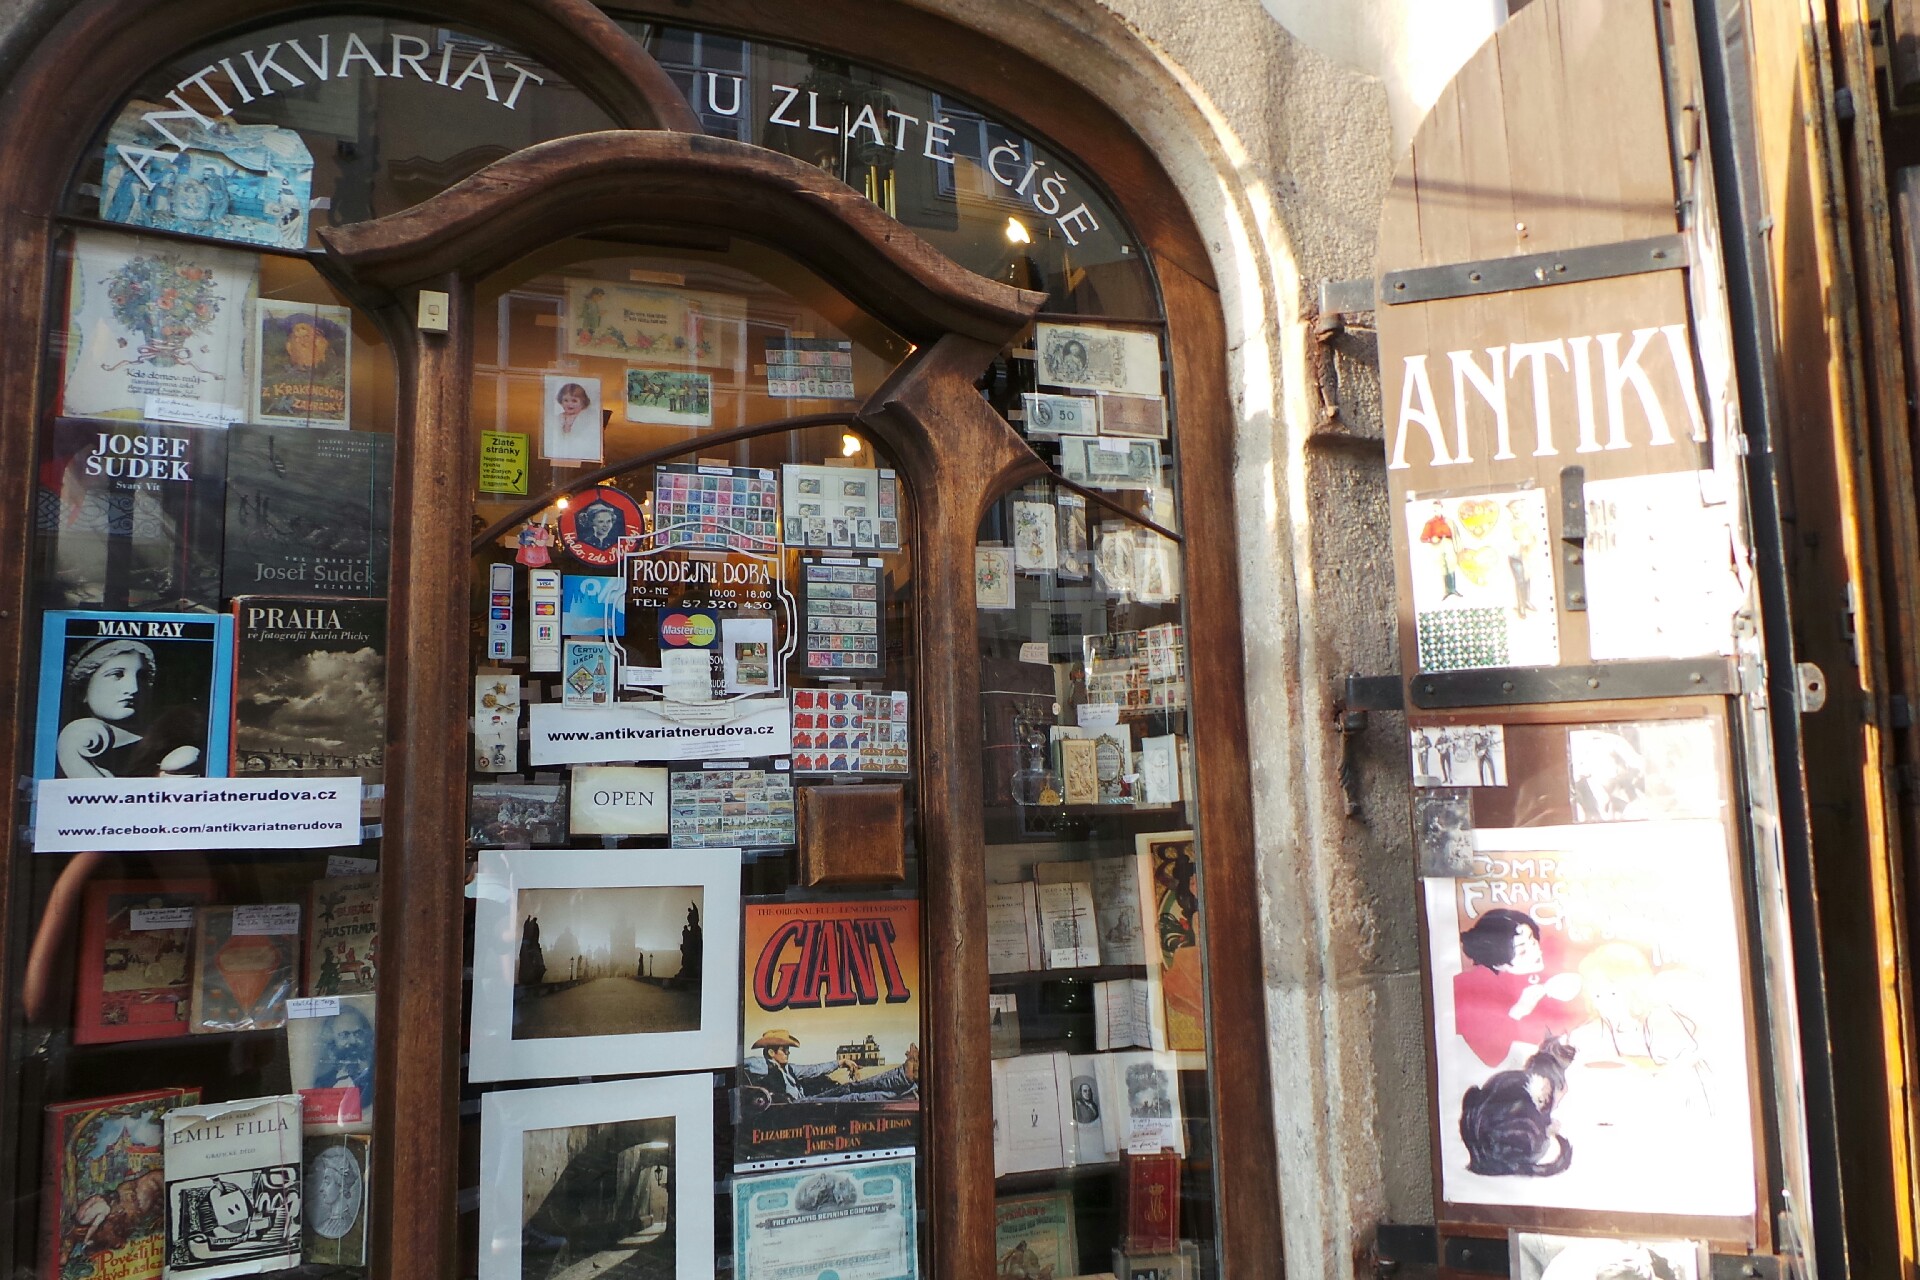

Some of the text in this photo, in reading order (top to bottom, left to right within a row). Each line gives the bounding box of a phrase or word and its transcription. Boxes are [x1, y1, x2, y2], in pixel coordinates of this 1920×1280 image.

[116, 32, 544, 191] ANTIKVARIÁT
[707, 72, 1100, 247] U ZLATÉ ČÍŠE
[1060, 410, 1075, 421] 50
[91, 432, 190, 459] JOSEF
[486, 446, 520, 456] stránky
[492, 437, 515, 447] Zlaté
[85, 455, 193, 481] SUDEK
[254, 561, 377, 584] Josef Sudek
[723, 562, 771, 585] DOBA
[632, 586, 647, 595] PO
[655, 586, 668, 596] NE
[633, 598, 666, 607] TEL:
[707, 600, 738, 609] 320
[743, 601, 772, 610] 430
[247, 607, 343, 630] PRAHA
[97, 620, 185, 638] MAN RAY
[247, 632, 259, 640] ve
[662, 622, 715, 636] MasterCard
[547, 724, 775, 742] www.antikvariatnerudova.cz
[67, 789, 337, 805] www.antikvariatnerudova.cz
[593, 791, 655, 807] OPEN
[57, 820, 343, 837] www.facebook.com/antikvariatnerudova
[757, 908, 773, 916] THE
[775, 907, 814, 916] ORIGINAL
[753, 917, 911, 1011] GIANT
[173, 1126, 225, 1145] EMIL
[236, 1117, 289, 1136] FILLA
[752, 1117, 912, 1144] ELIZABETH TAYLOR ROCK HUDSON
[805, 1136, 861, 1155] JAMES DEAN
[772, 1219, 785, 1227] THE
[786, 1214, 817, 1225] ATLANTIC
[849, 1205, 880, 1217] COMPANY
